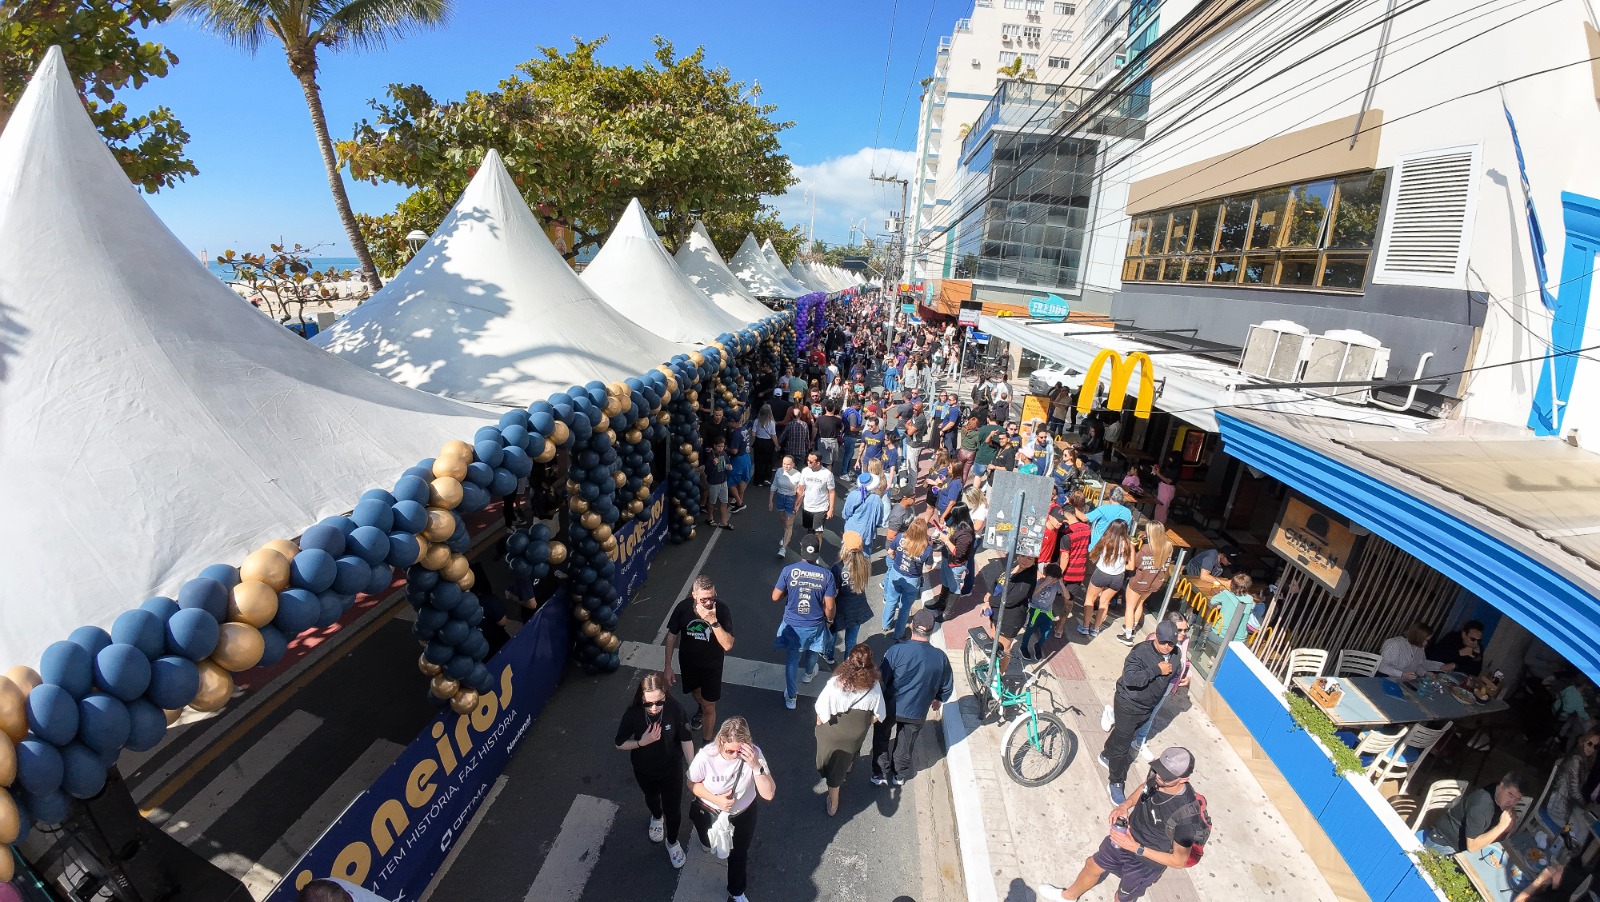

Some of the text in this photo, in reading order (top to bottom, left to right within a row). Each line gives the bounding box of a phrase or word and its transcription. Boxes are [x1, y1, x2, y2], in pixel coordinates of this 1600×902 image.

[378, 847, 406, 880] TEM
[406, 785, 460, 848] HISTÓRIA,
[458, 756, 479, 784] FAZ
[478, 709, 518, 760] HISTÓRIA
[453, 783, 488, 831] OPTIMA
